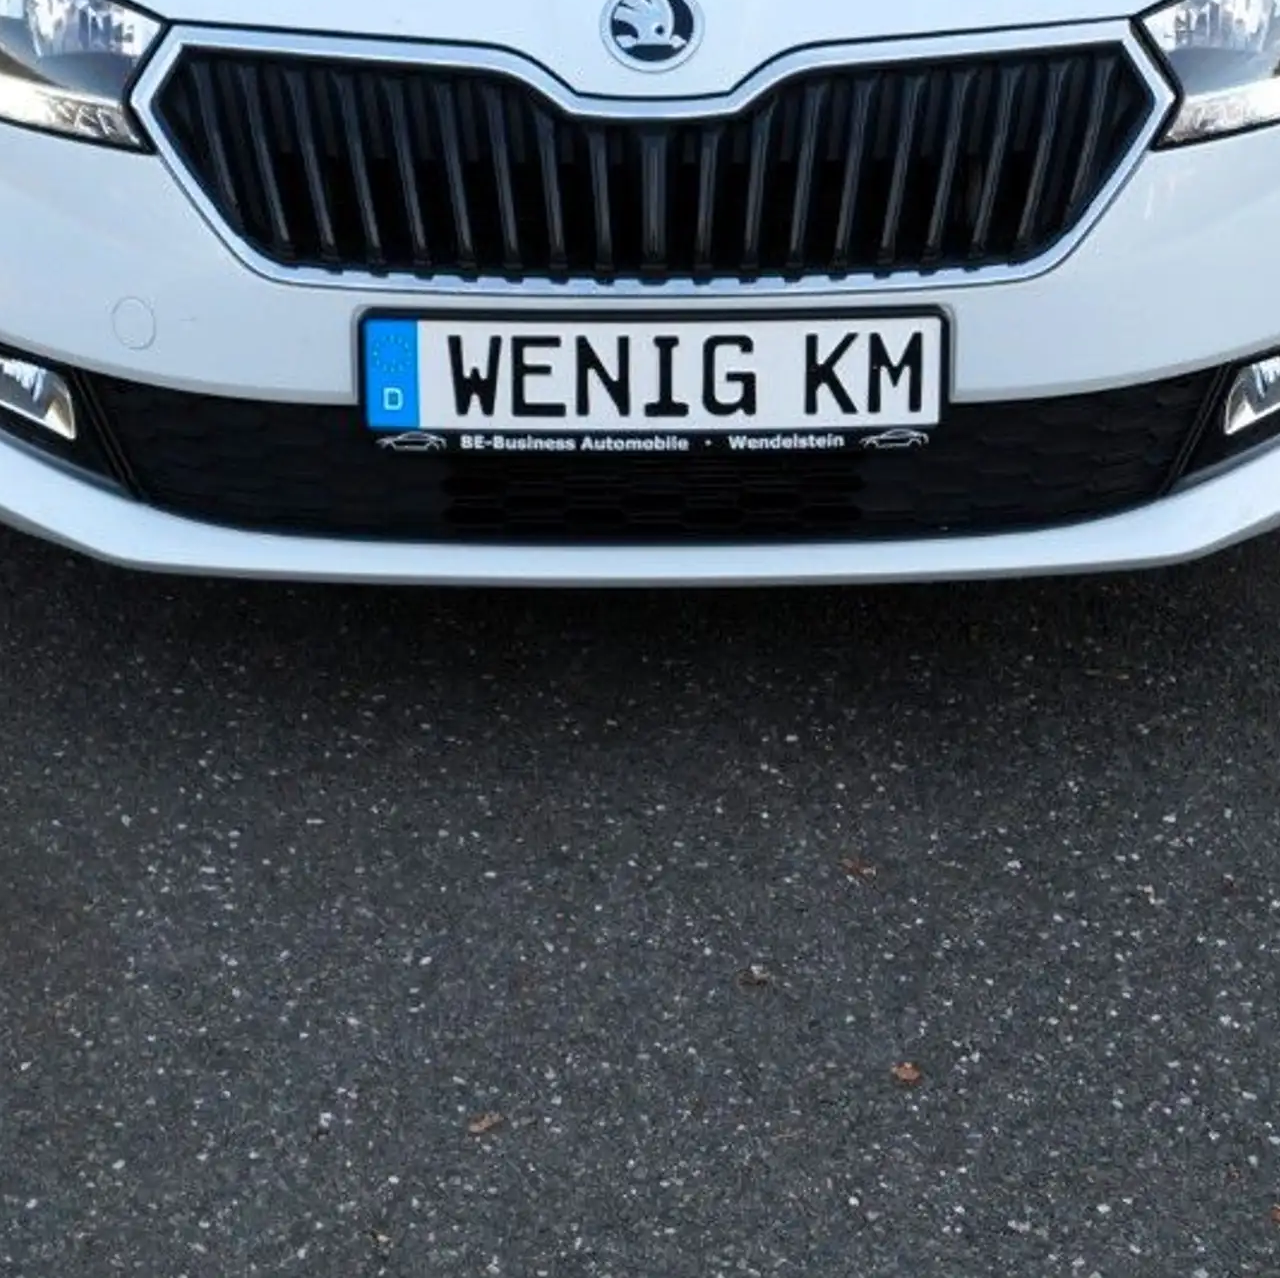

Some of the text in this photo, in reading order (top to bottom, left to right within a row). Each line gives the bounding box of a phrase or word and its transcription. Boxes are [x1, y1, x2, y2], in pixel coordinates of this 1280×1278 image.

[447, 332, 923, 417] WENIG KM
[383, 387, 403, 411] D
[460, 432, 845, 451] BE-Business Automobile Wendelstein
